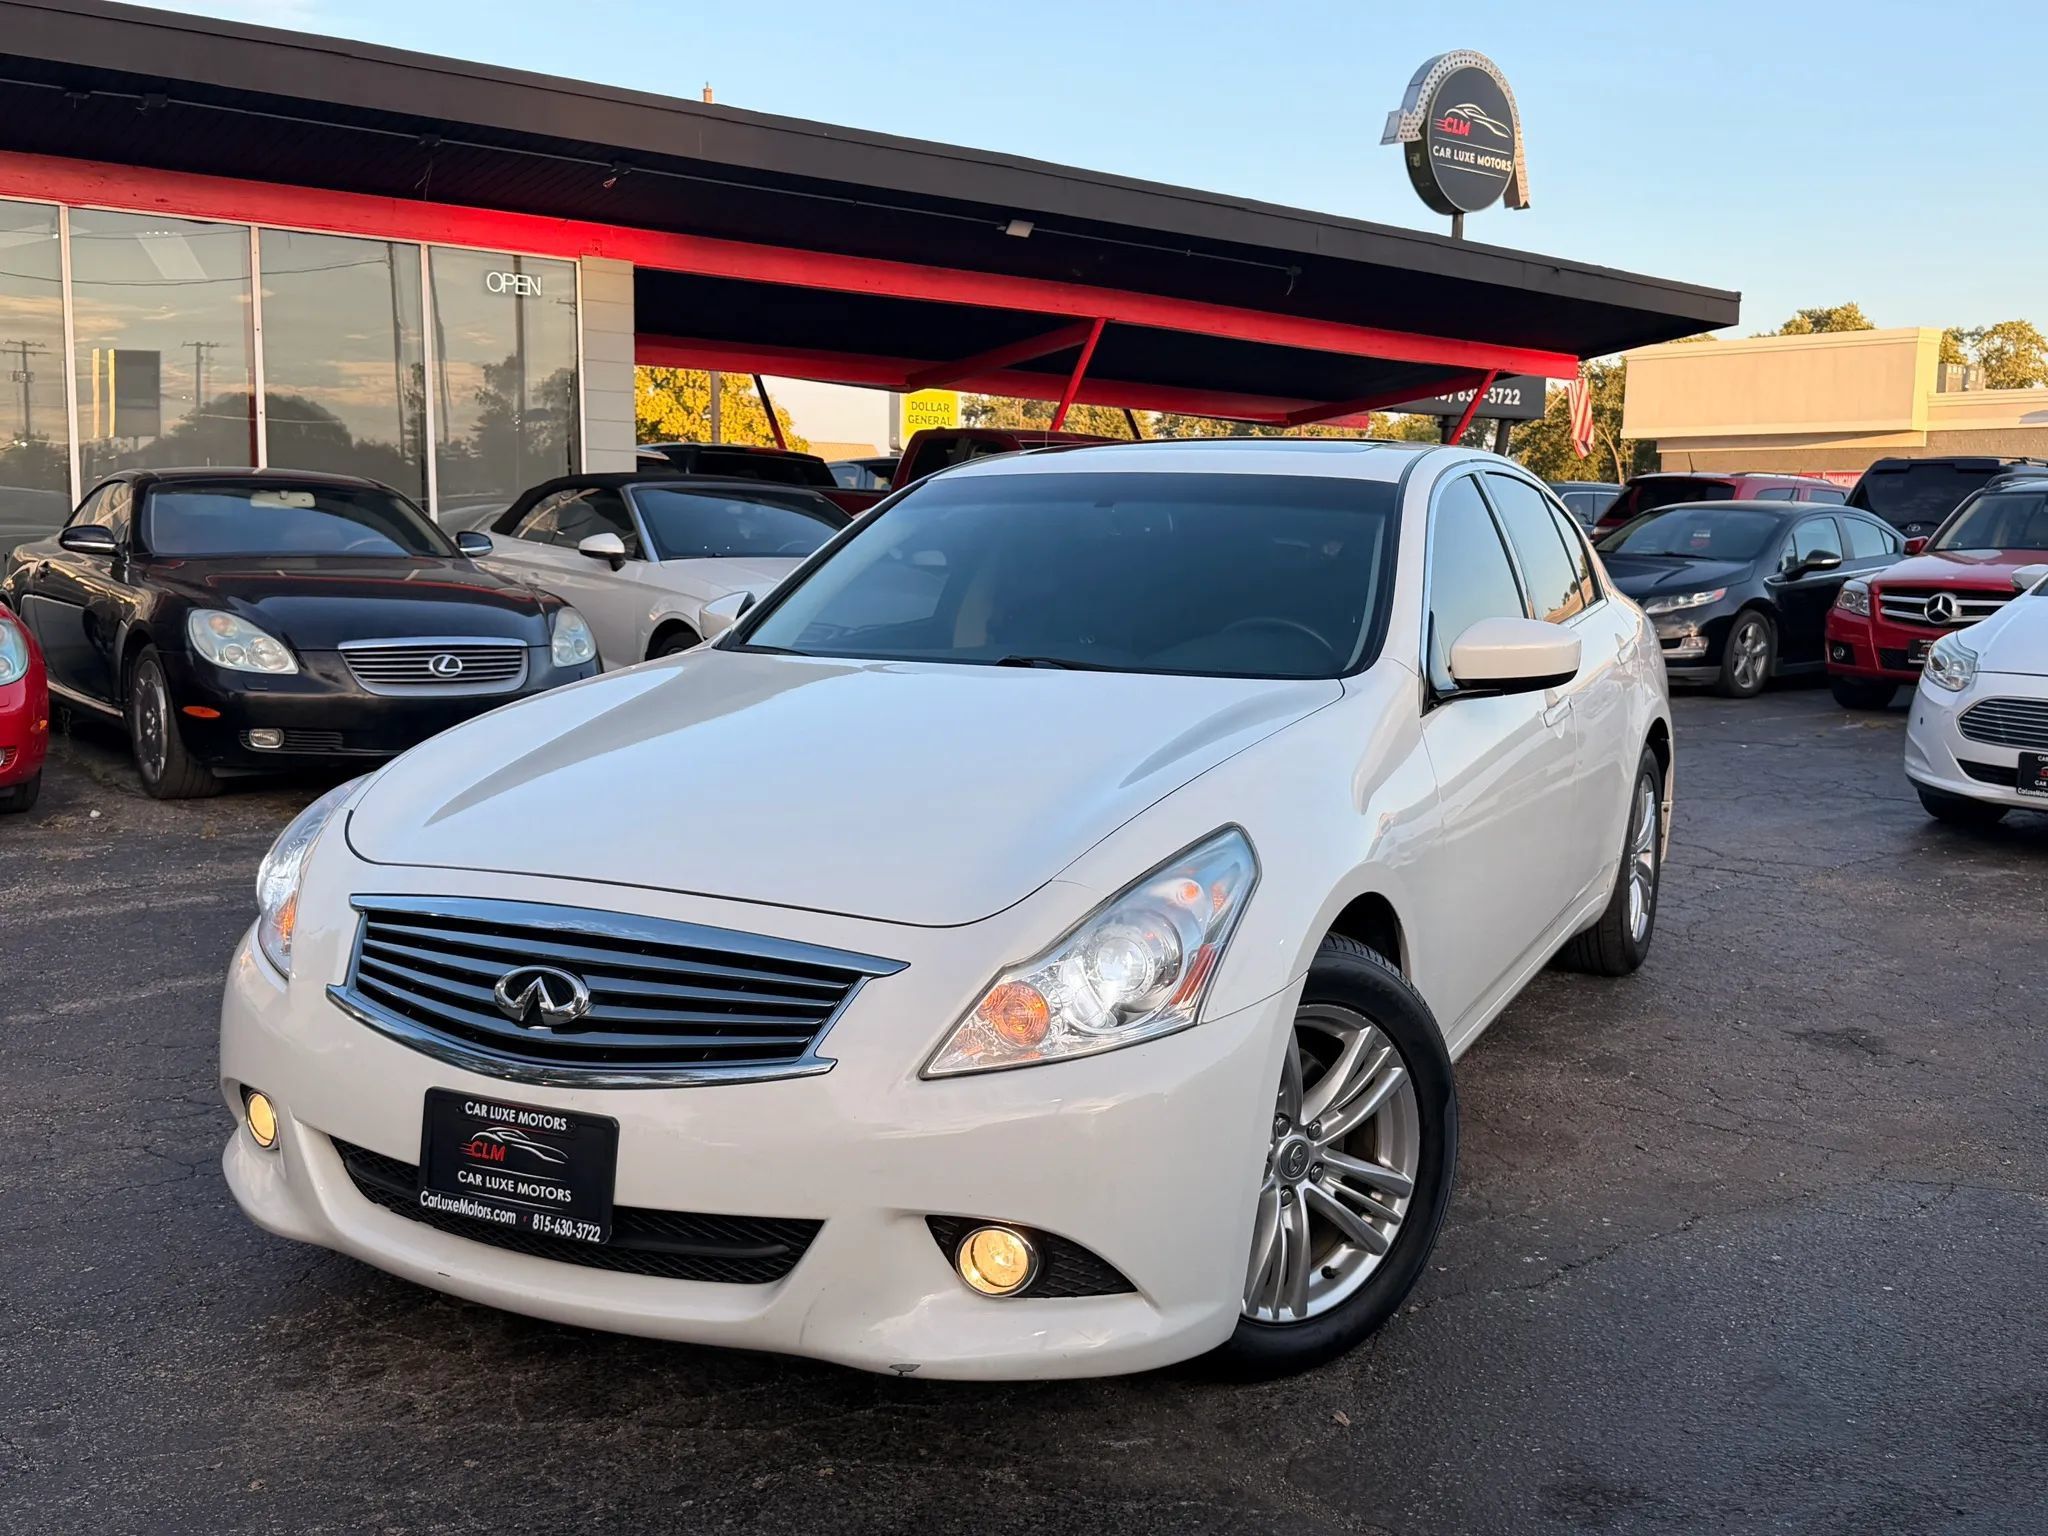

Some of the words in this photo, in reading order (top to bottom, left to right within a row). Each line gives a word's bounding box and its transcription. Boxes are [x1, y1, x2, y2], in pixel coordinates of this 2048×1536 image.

[1444, 117, 1471, 136] CLM
[1432, 145, 1451, 159] CAR
[1453, 149, 1476, 164] LUXE
[1477, 155, 1512, 172] MOTORS
[486, 272, 541, 296] OPEN
[911, 401, 950, 413] DOLLAR
[908, 414, 952, 426] GENERAL
[465, 1101, 487, 1118] CAR
[490, 1106, 516, 1123] LUXE
[517, 1111, 567, 1131] MOTORS
[470, 1140, 507, 1162] CLM
[457, 1170, 482, 1186] CAR
[486, 1175, 514, 1192] LUXE
[517, 1182, 572, 1202] MOTORS
[420, 1190, 516, 1225] CarLuxeMotors.com
[532, 1213, 601, 1242] 815-630-3722
